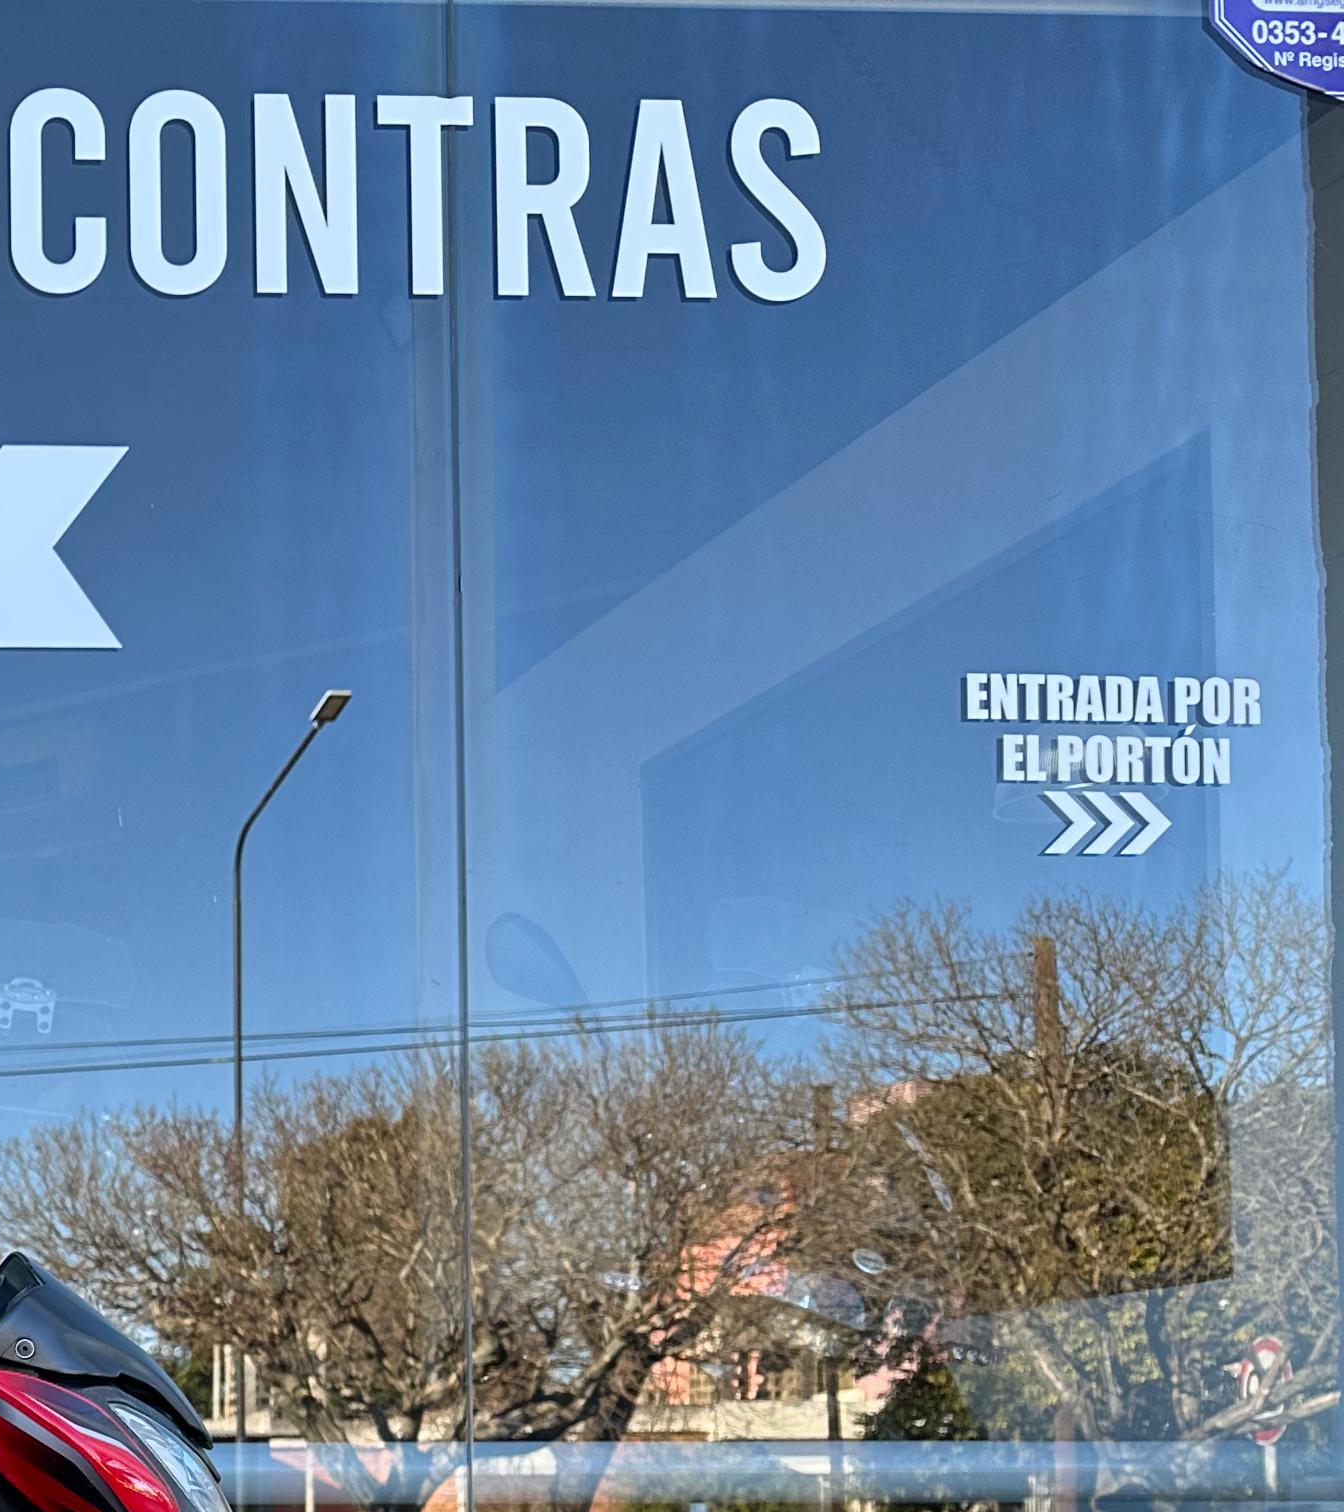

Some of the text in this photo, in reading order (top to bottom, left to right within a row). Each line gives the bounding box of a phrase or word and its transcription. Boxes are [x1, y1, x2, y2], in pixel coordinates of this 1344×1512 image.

[965, 672, 1262, 725] ENTRADA POR
[1002, 723, 1231, 785] EL PORTÓN
